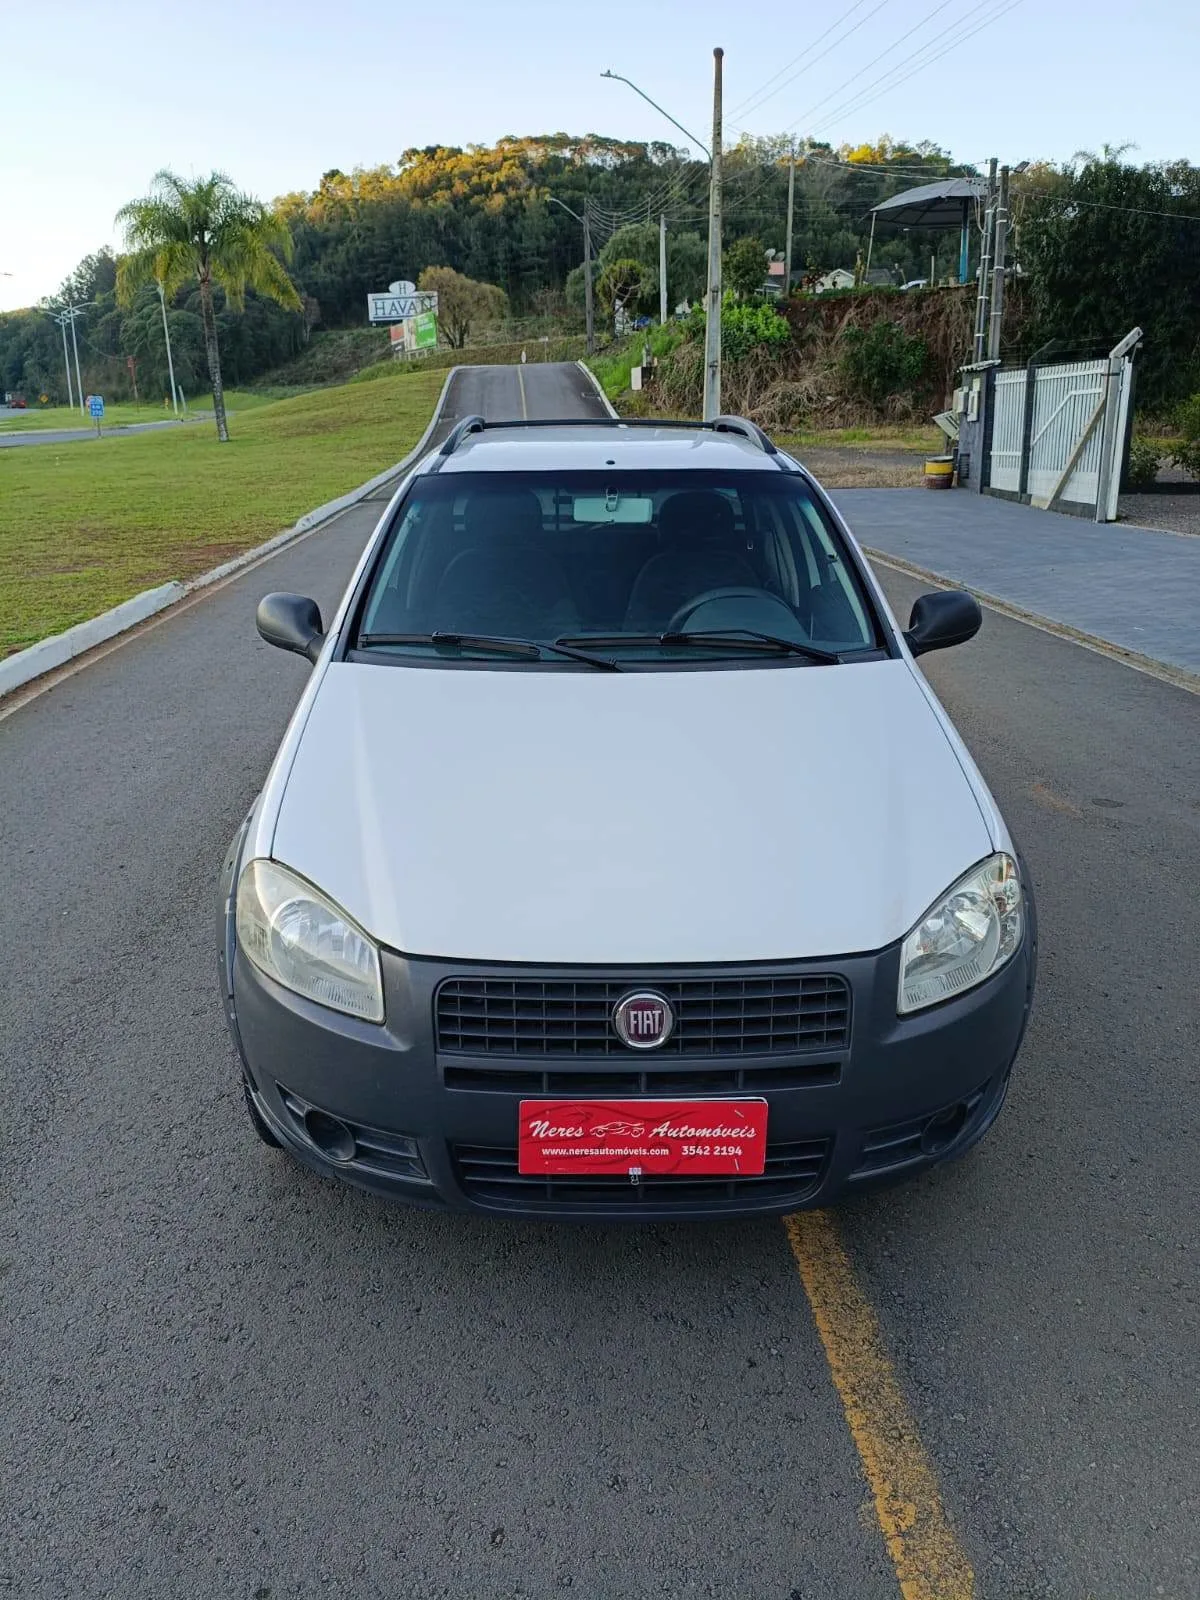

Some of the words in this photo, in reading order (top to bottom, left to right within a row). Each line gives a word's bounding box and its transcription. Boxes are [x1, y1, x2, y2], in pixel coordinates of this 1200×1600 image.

[374, 298, 432, 316] HAVAN
[629, 1010, 662, 1034] FIAT
[529, 1120, 584, 1138] Neres
[649, 1120, 757, 1139] Automóveis
[681, 1145, 710, 1156] 3542
[713, 1145, 743, 1156] 2194
